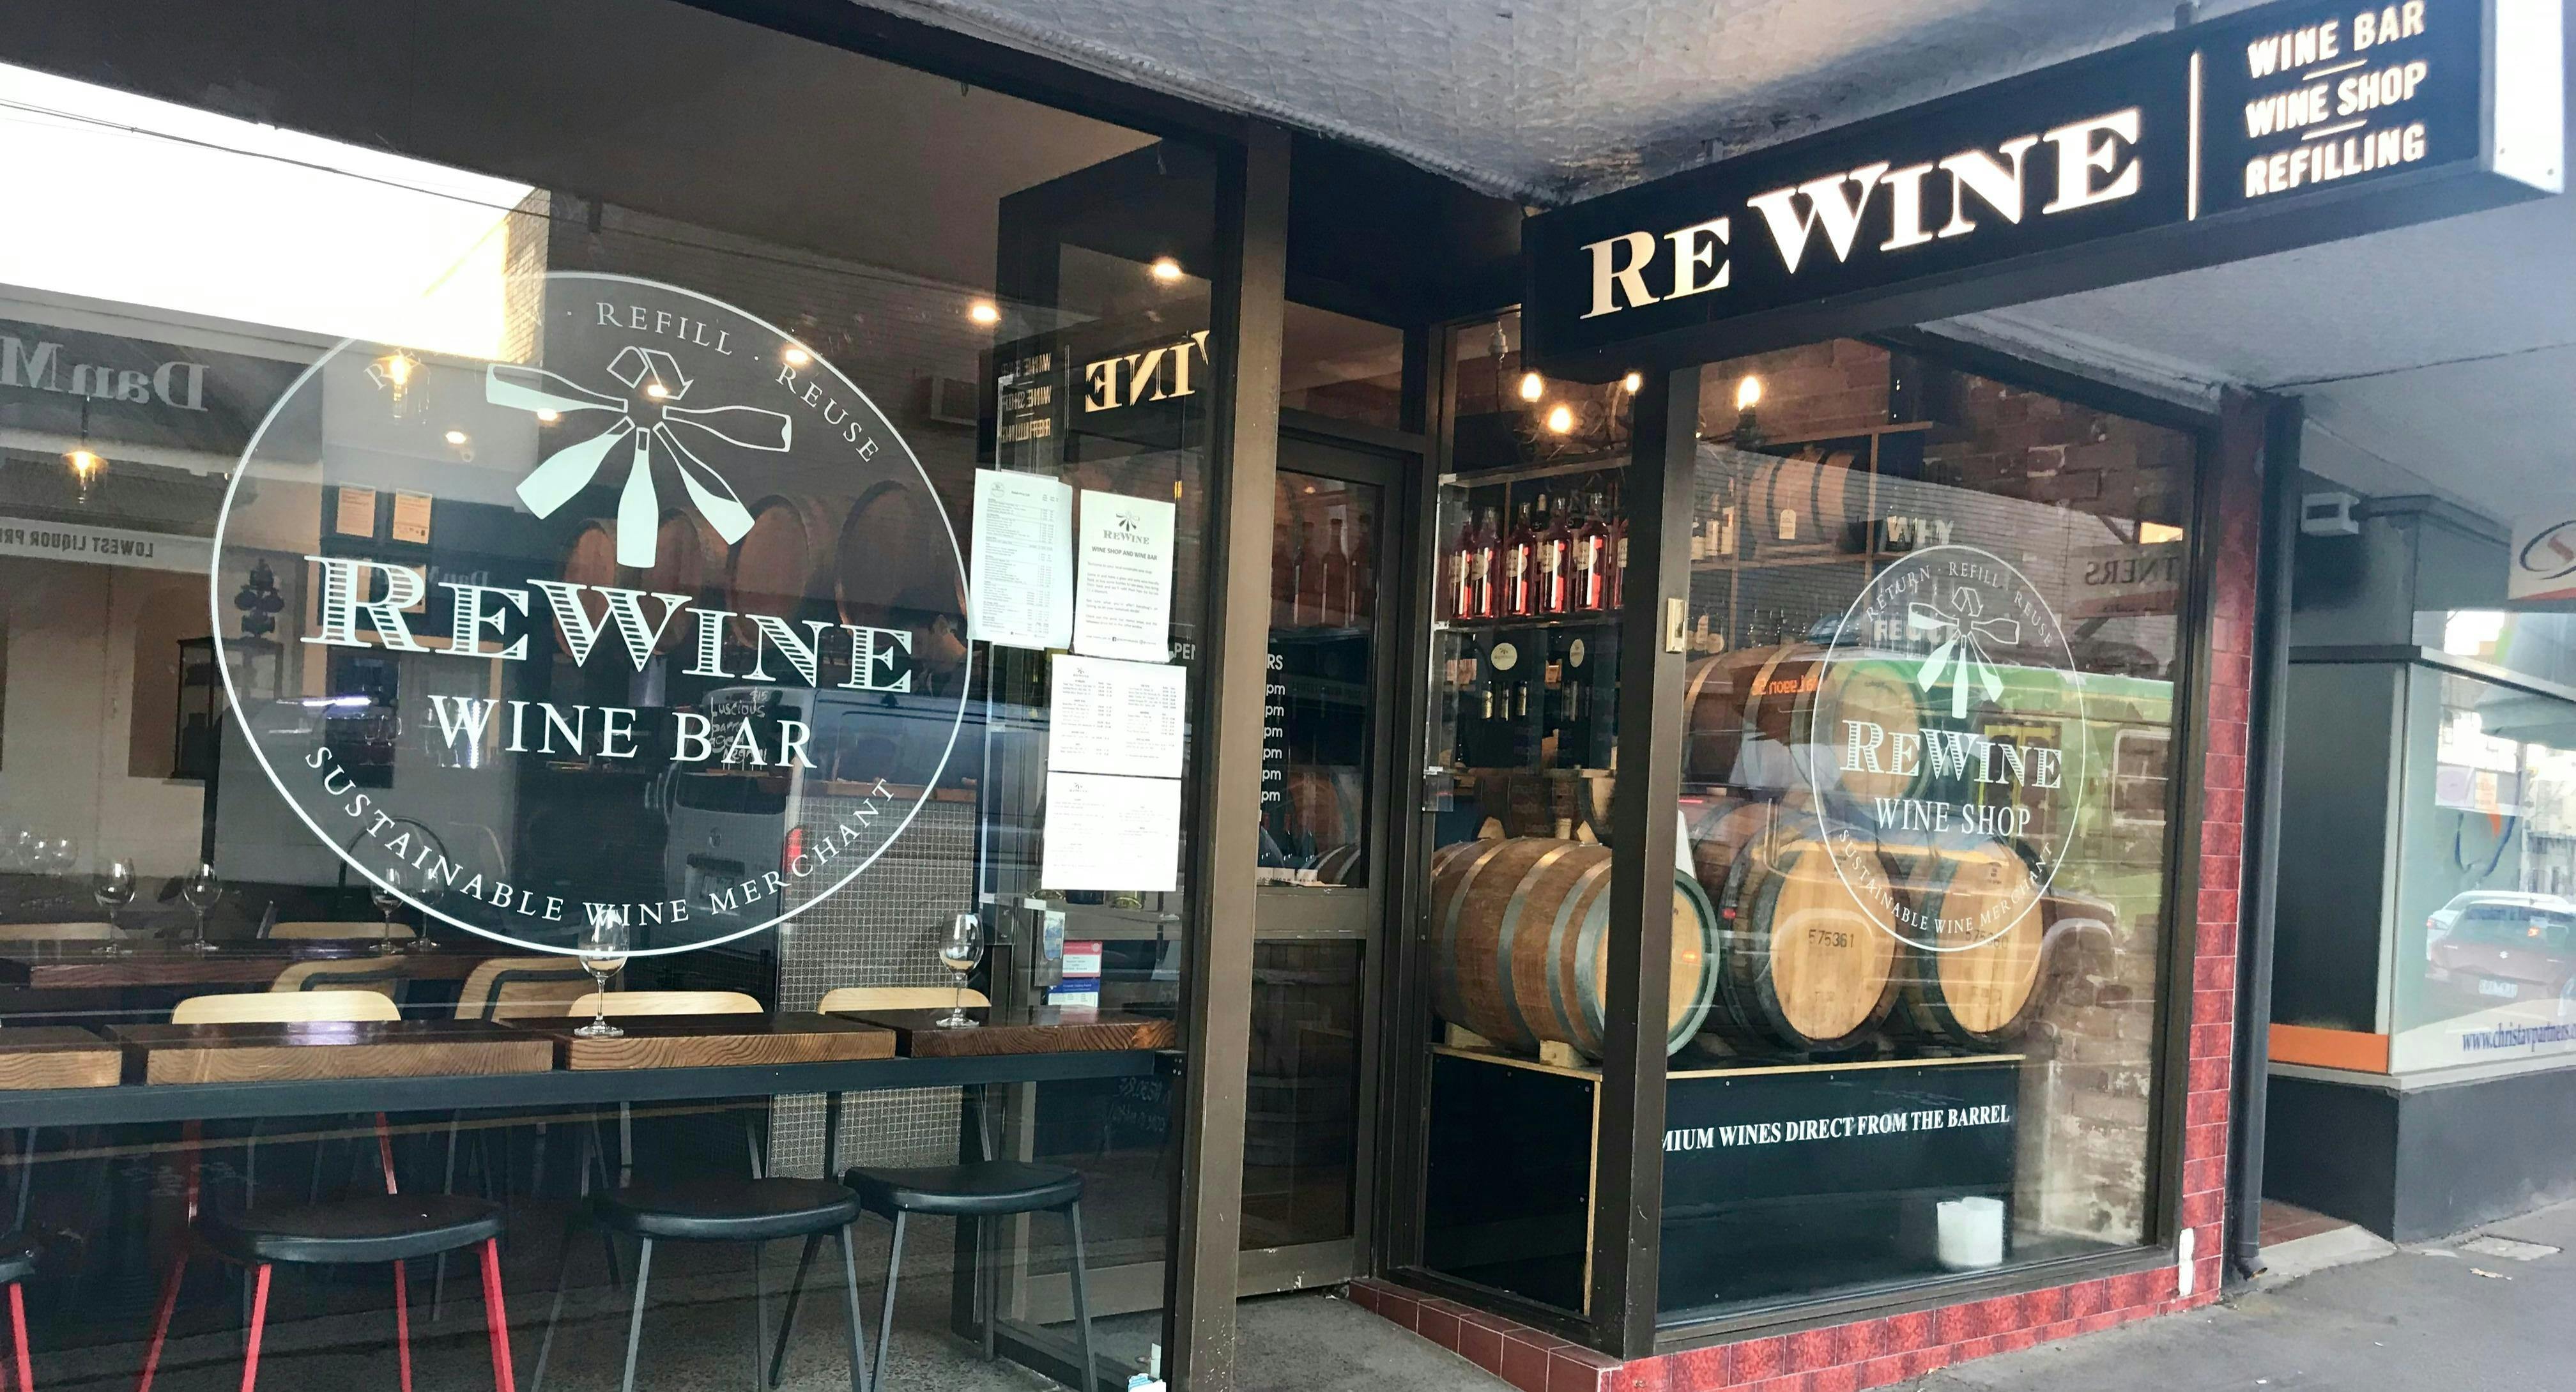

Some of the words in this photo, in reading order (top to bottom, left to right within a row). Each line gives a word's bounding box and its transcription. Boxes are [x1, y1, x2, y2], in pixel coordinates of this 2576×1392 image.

[2248, 20, 2340, 79] WINE
[2353, 0, 2425, 52] BAR
[2245, 85, 2329, 138] WINE
[2336, 62, 2428, 115] SHOP
[2245, 124, 2426, 197] REFILLING
[1579, 217, 1730, 320] RE
[1747, 106, 2141, 274] WINE
[595, 302, 733, 355] REFILL
[775, 363, 879, 463] REUSE
[1103, 530, 1150, 545] REWINE
[300, 555, 912, 694] REWINE
[1866, 565, 1932, 623] RETURN
[1949, 562, 1999, 589] REFILL
[2014, 593, 2053, 648] REUSE
[1265, 705, 1284, 718] pm
[1266, 684, 1285, 697] pm
[427, 694, 638, 759] WINE
[670, 712, 818, 769] BAR
[1263, 748, 1282, 761] pm
[1264, 726, 1283, 739] pm
[1839, 719, 2062, 790] REWINE
[1261, 791, 1280, 804] pm
[1262, 769, 1282, 782] pm
[305, 746, 565, 922] SUSTAINABLE
[582, 899, 689, 927] WINE
[709, 778, 896, 915] MERCHANT
[1874, 797, 1950, 832] WINE
[1961, 802, 2031, 837] SHOP
[1839, 829, 1928, 932] SUSTAINABLE
[1934, 917, 1974, 935] WINE
[1980, 843, 2053, 928] MERCHANT
[1808, 929, 1854, 949] 575361
[1719, 1122, 1782, 1147] WINES
[1784, 1117, 1852, 1143] DIRECT
[1857, 1112, 1907, 1136] FROM
[1910, 1109, 1943, 1132] THE
[1947, 1104, 2011, 1128] BARREL
